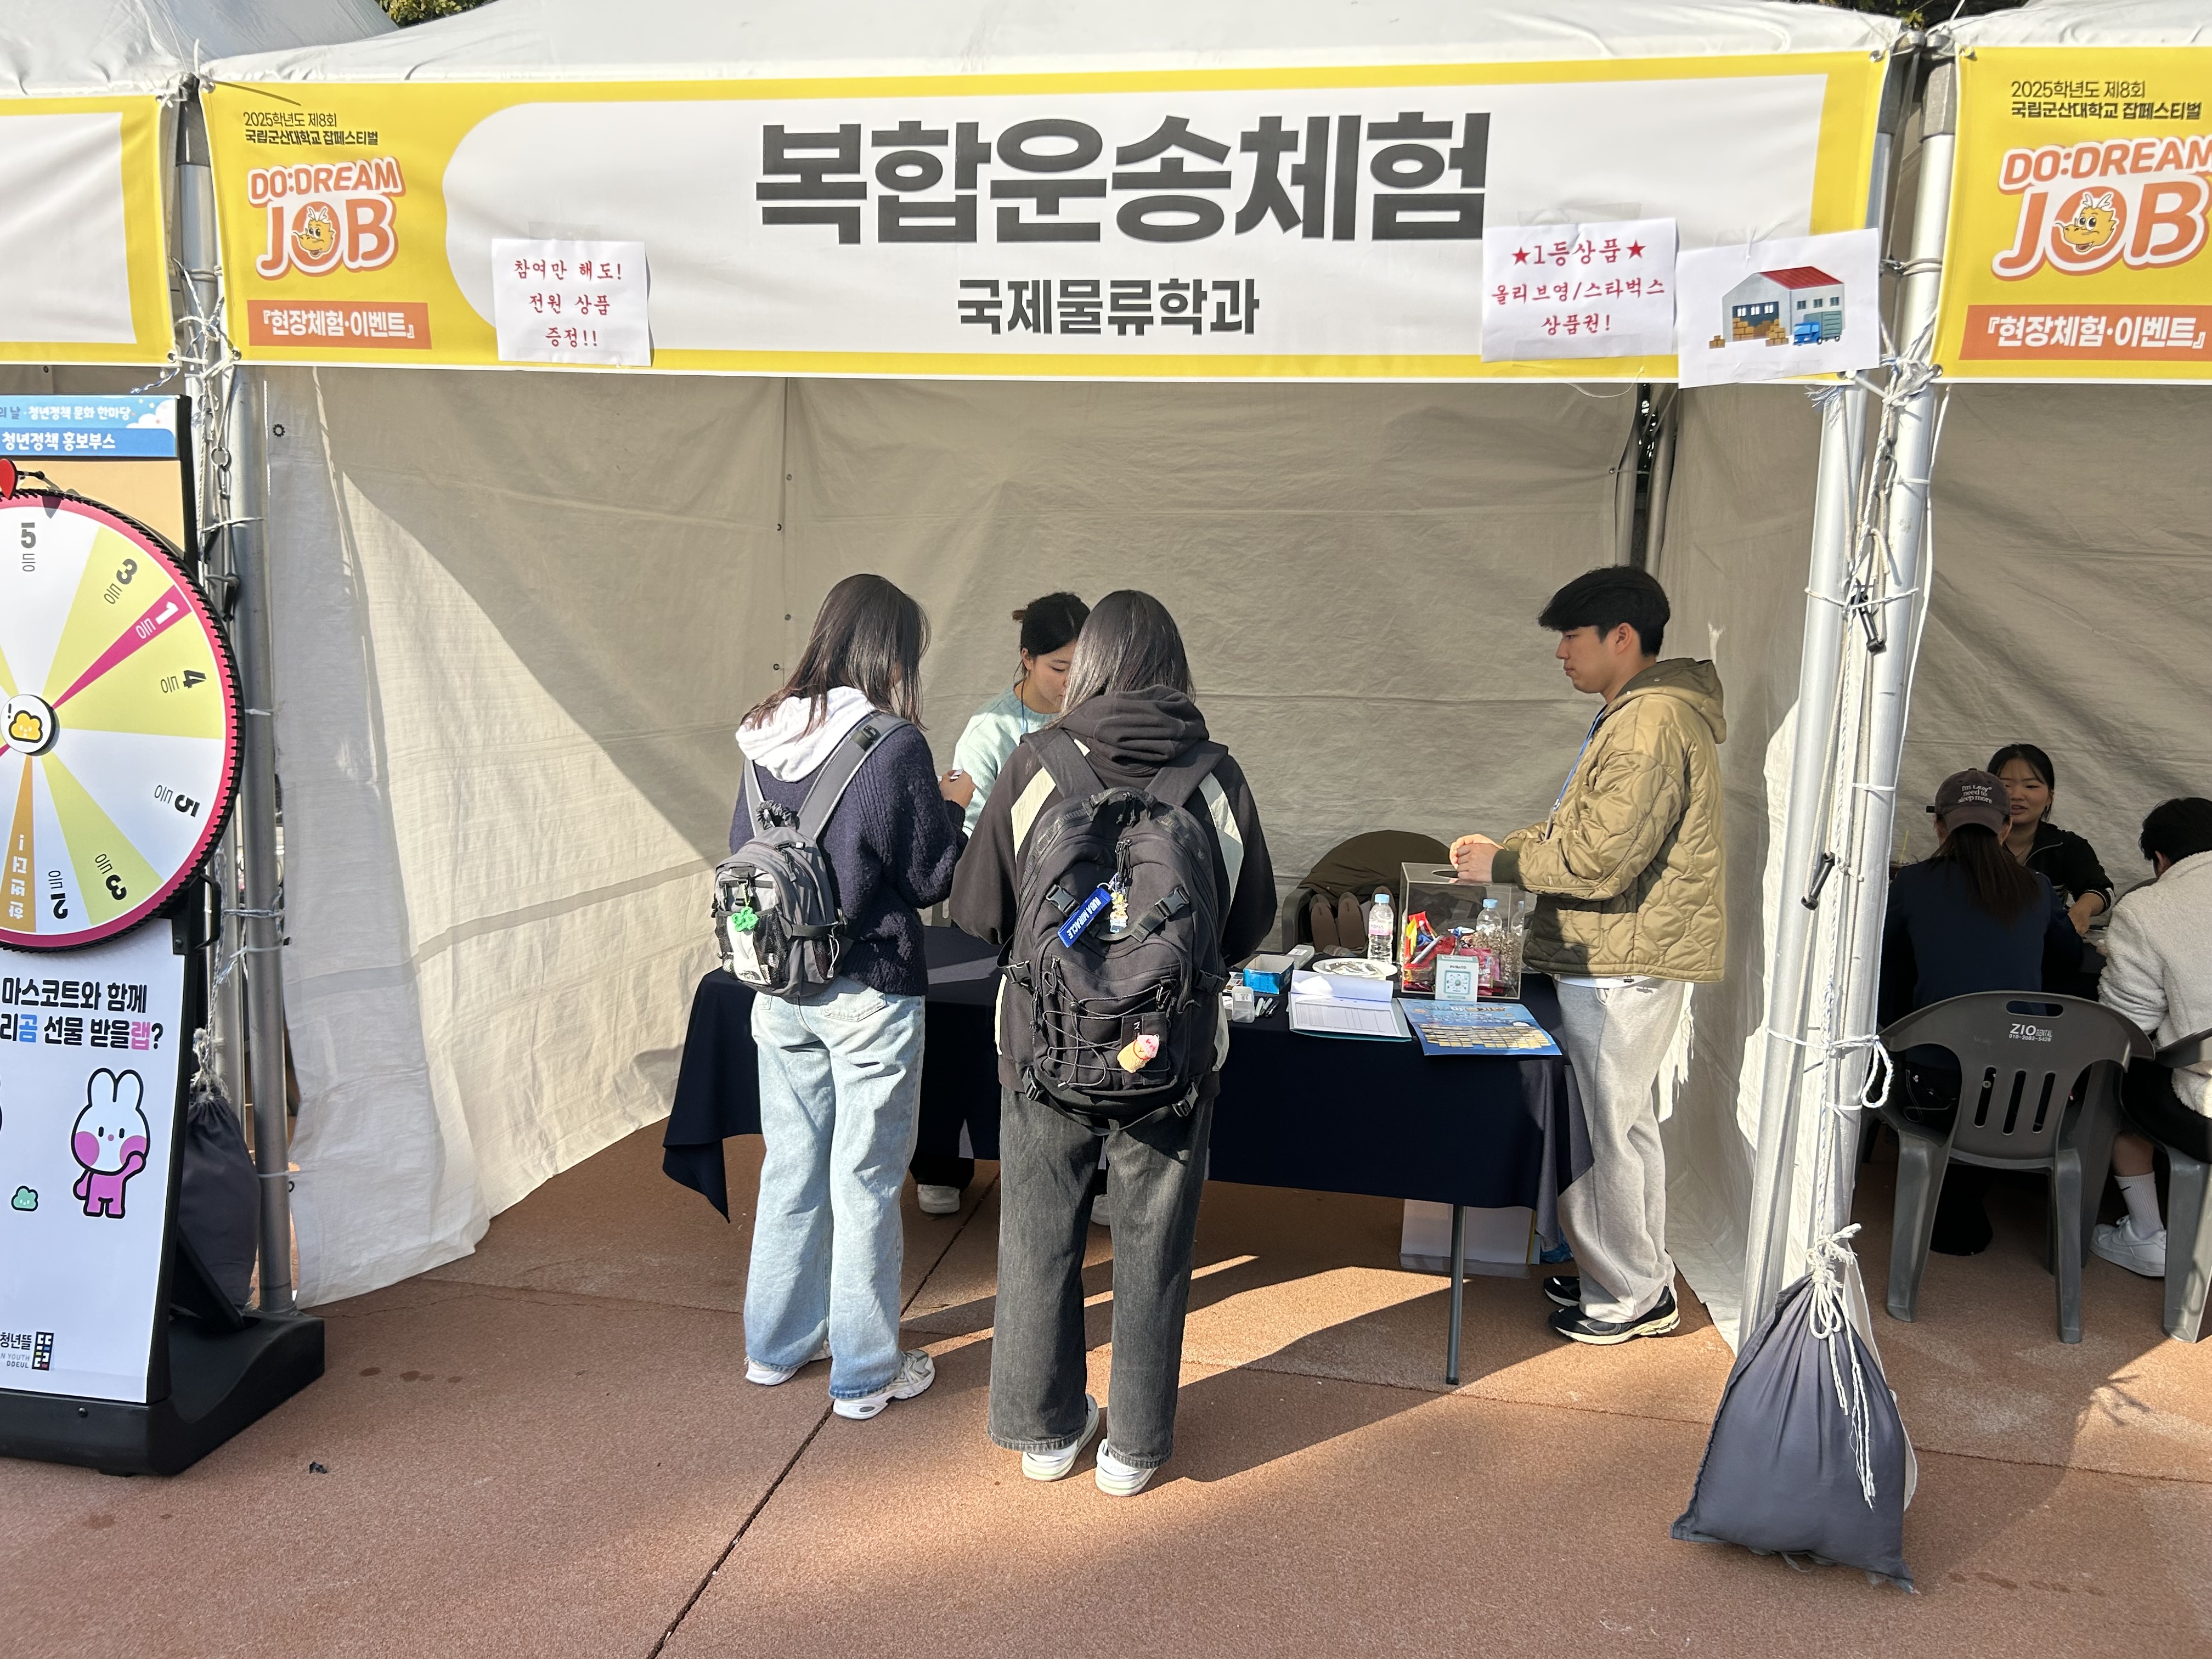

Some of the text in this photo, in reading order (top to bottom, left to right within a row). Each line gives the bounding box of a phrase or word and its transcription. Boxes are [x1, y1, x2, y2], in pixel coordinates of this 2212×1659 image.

[2011, 80, 2146, 99] 2025학년도 제8회
[243, 111, 337, 127] 2025학년도 제8회
[2011, 101, 2203, 121] 국립군산대학교 잡페스티벌
[245, 129, 379, 146] 국립군산대학교 잡페스티벌
[2002, 138, 2212, 186] DO:DREAM
[250, 161, 399, 201] DO:DREAM
[755, 111, 1492, 245] 복합운송체험
[260, 198, 391, 272] JOB
[1998, 180, 2203, 270] JOB
[514, 258, 622, 281] 참여만 해도!
[1491, 277, 1666, 306] 올리브영/스타벅스
[528, 292, 611, 315] 전원 상품
[957, 278, 1260, 336] 국제물류학과
[1541, 313, 1611, 336] 상품권!
[545, 327, 597, 348] 증정!!
[9, 406, 21, 420] 날
[28, 405, 71, 421] 청년정책
[74, 405, 95, 420] 문화
[97, 405, 131, 421] 한마당
[2, 431, 116, 452] 청년정책 홍보부스
[1066, 907, 1090, 940] MIRACLE
[2, 977, 148, 1013] 마스코트와 함께
[43, 1015, 83, 1046] 선물
[2010, 1023, 2036, 1036] ZIO
[0, 1331, 32, 1351] 청년뜰
[6, 1360, 29, 1369] DDEUL
[8, 1353, 31, 1362] YOUTH
